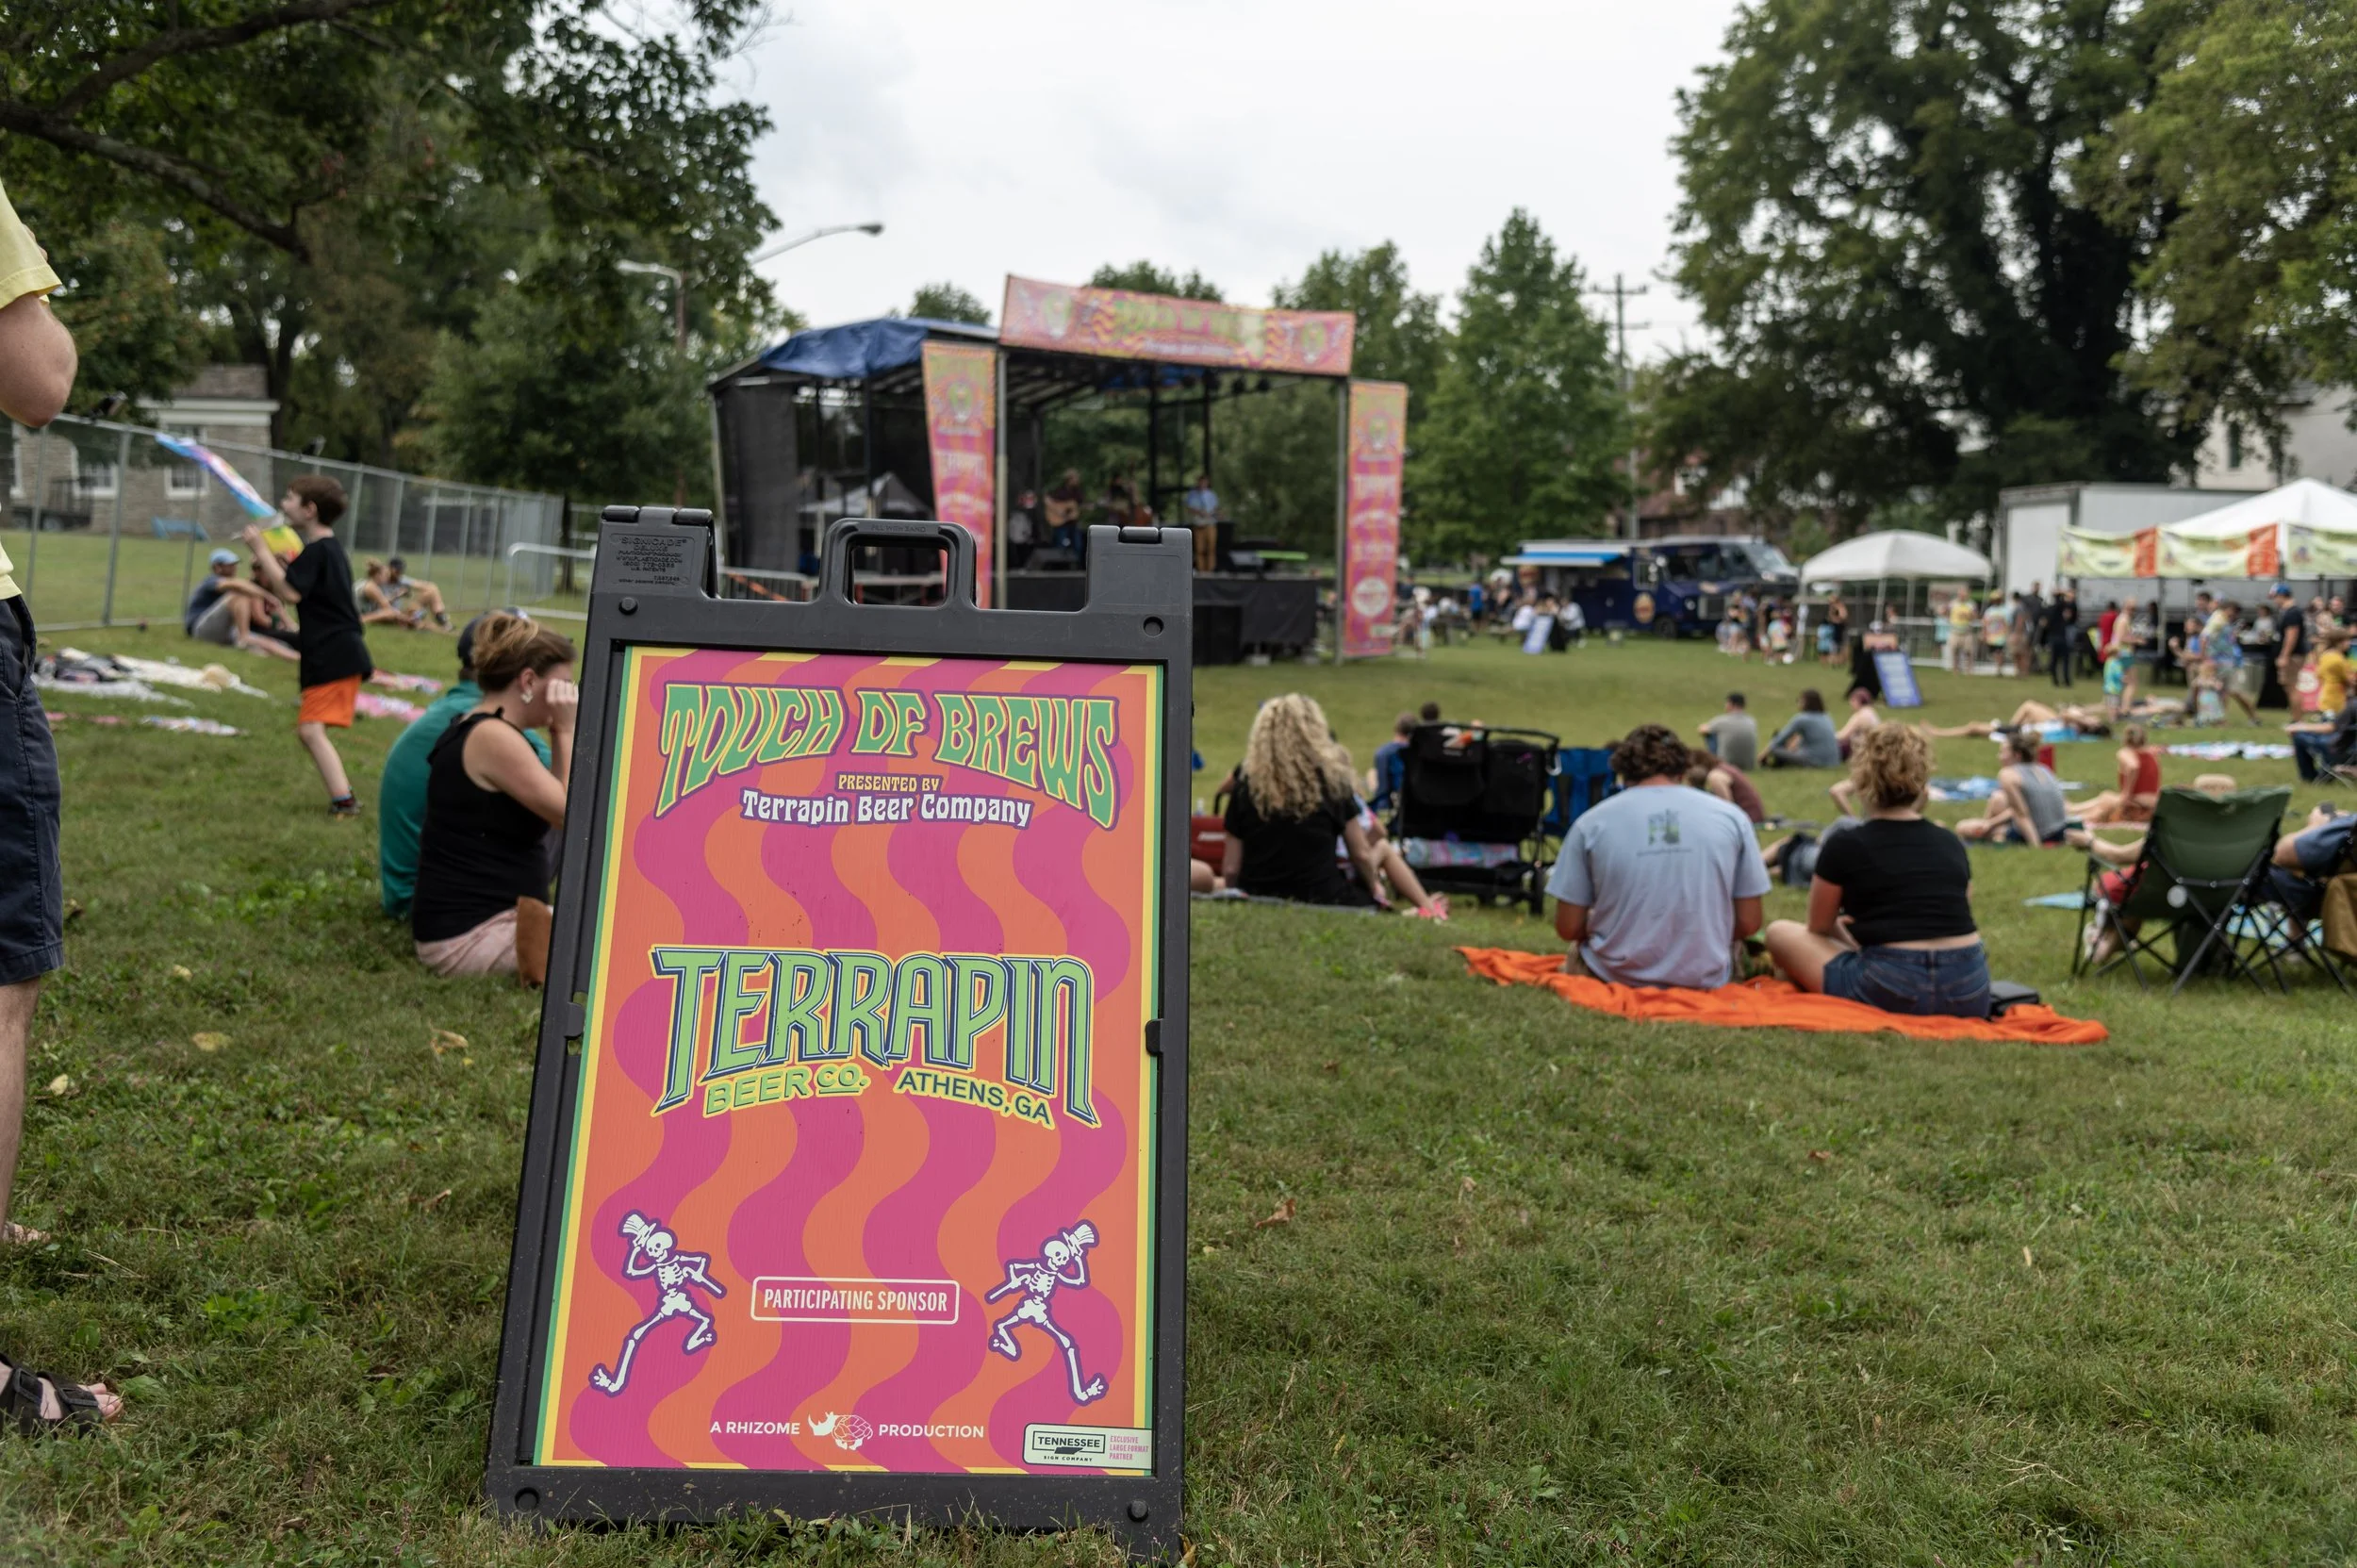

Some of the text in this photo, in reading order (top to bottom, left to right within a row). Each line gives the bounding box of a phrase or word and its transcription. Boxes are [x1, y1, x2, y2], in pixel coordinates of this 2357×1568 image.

[656, 684, 1114, 829] TOUCH OF BREWS
[838, 773, 940, 793] PRESENTED BY
[743, 789, 1032, 828] Terrapin Beer Company
[651, 946, 1099, 1126] TERRAPIN
[706, 1066, 813, 1115] BEER
[816, 1066, 868, 1094] CO.
[763, 1288, 948, 1312] PARTICIPATING SPONSOR
[710, 1421, 985, 1439] A RHIZOME PRODUCTION
[1110, 1435, 1139, 1444] EXCLUSIVE
[1038, 1436, 1101, 1448] TENNESSEE
[1109, 1452, 1133, 1461] PARTNER
